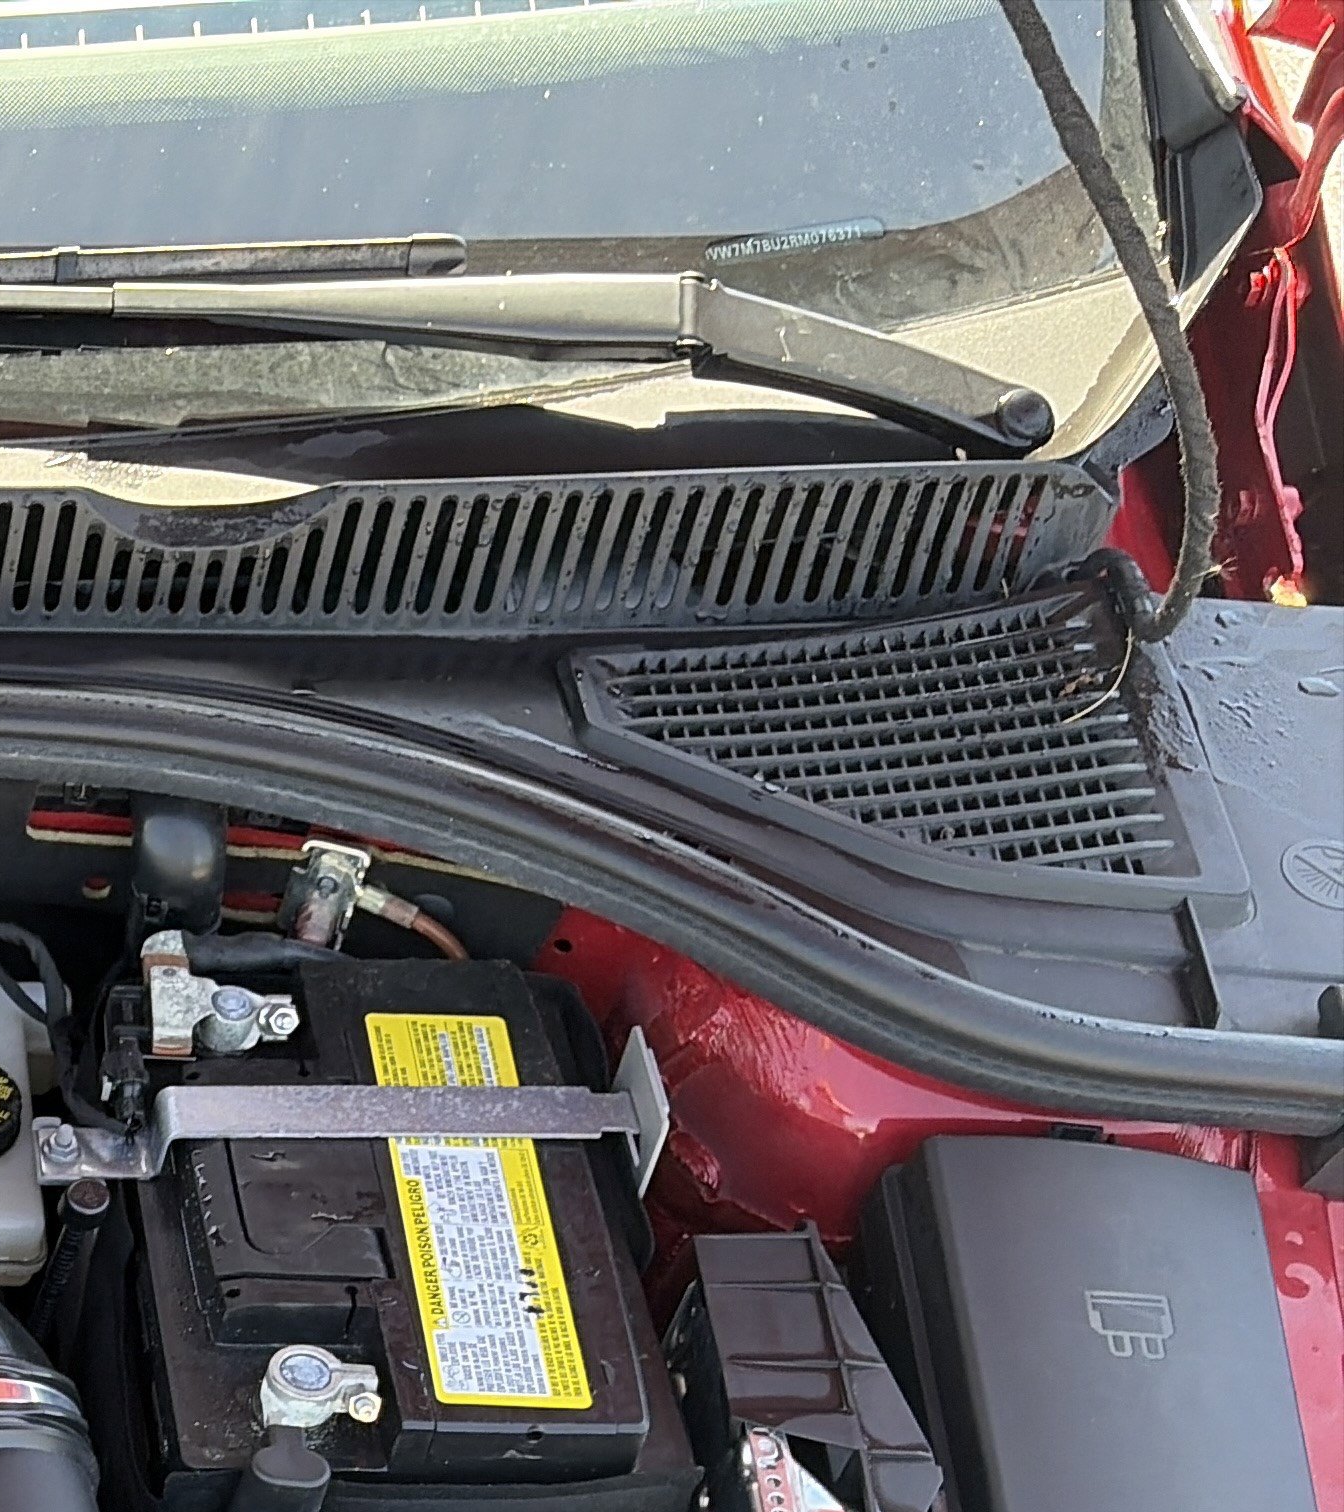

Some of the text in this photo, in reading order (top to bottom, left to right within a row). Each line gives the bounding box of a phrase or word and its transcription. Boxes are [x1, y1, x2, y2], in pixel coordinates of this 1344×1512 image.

[406, 1179, 444, 1315] DANGER POISON PELIGRO
